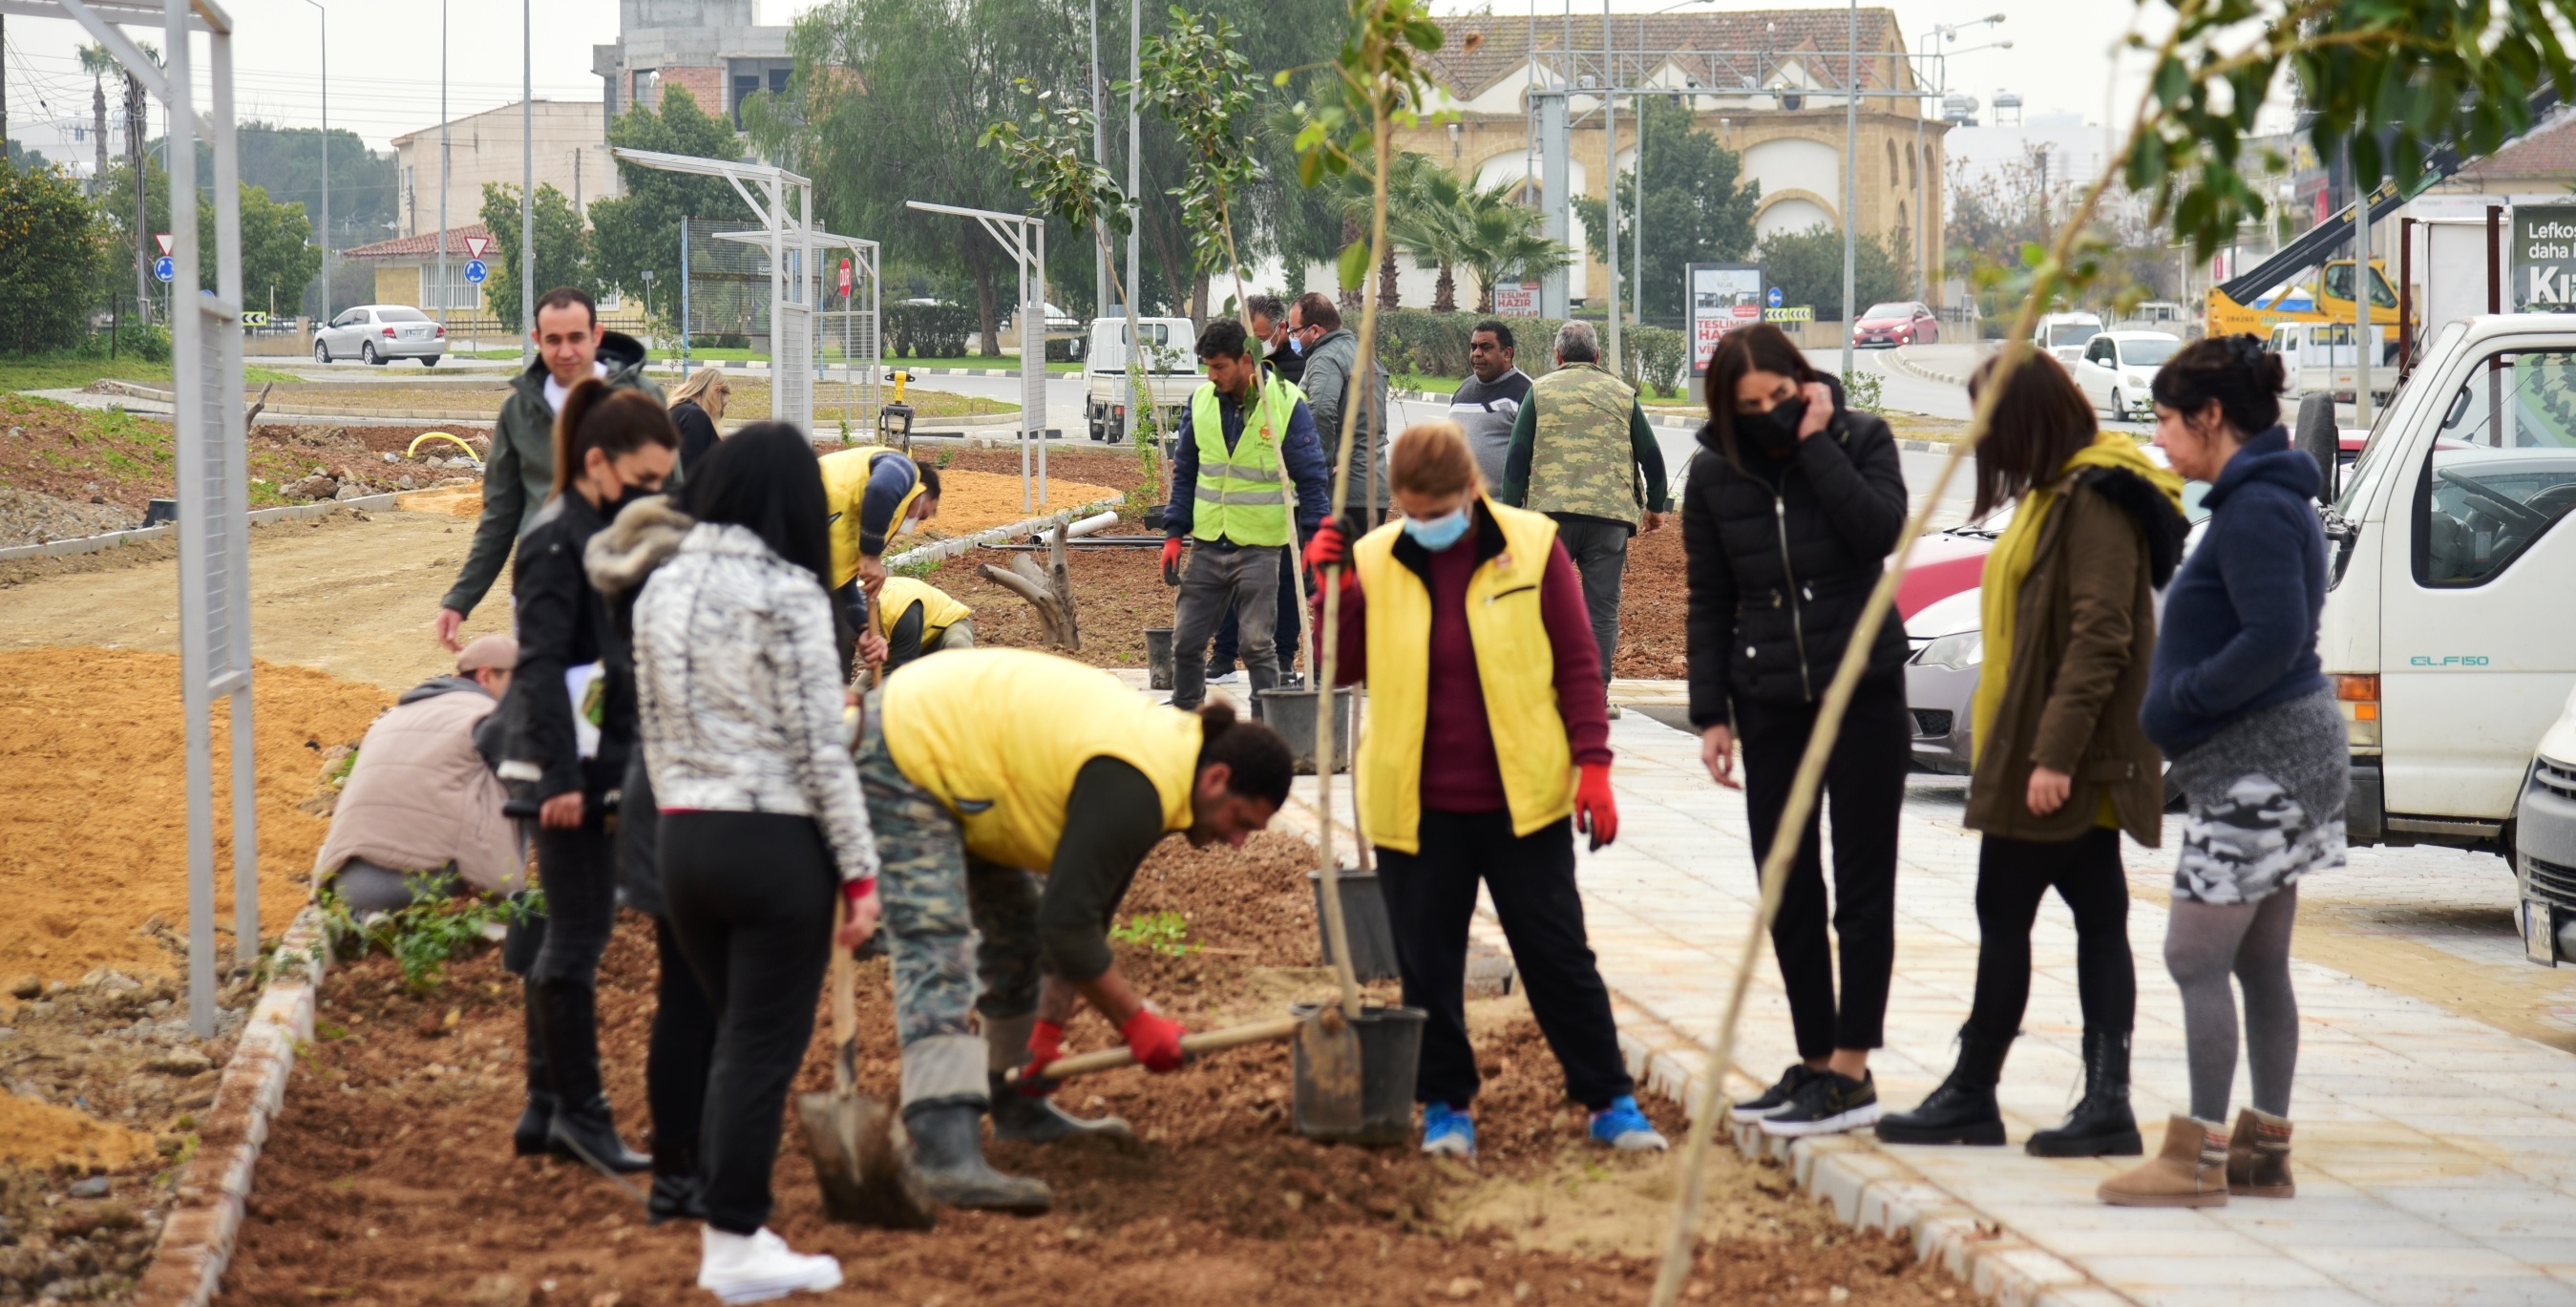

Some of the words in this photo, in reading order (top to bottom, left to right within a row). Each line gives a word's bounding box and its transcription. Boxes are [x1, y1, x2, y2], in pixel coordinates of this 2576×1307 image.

[2528, 242, 2569, 259] daha
[840, 267, 850, 286] DUR
[2530, 265, 2576, 304] Kı
[1498, 299, 1531, 307] HAZIR
